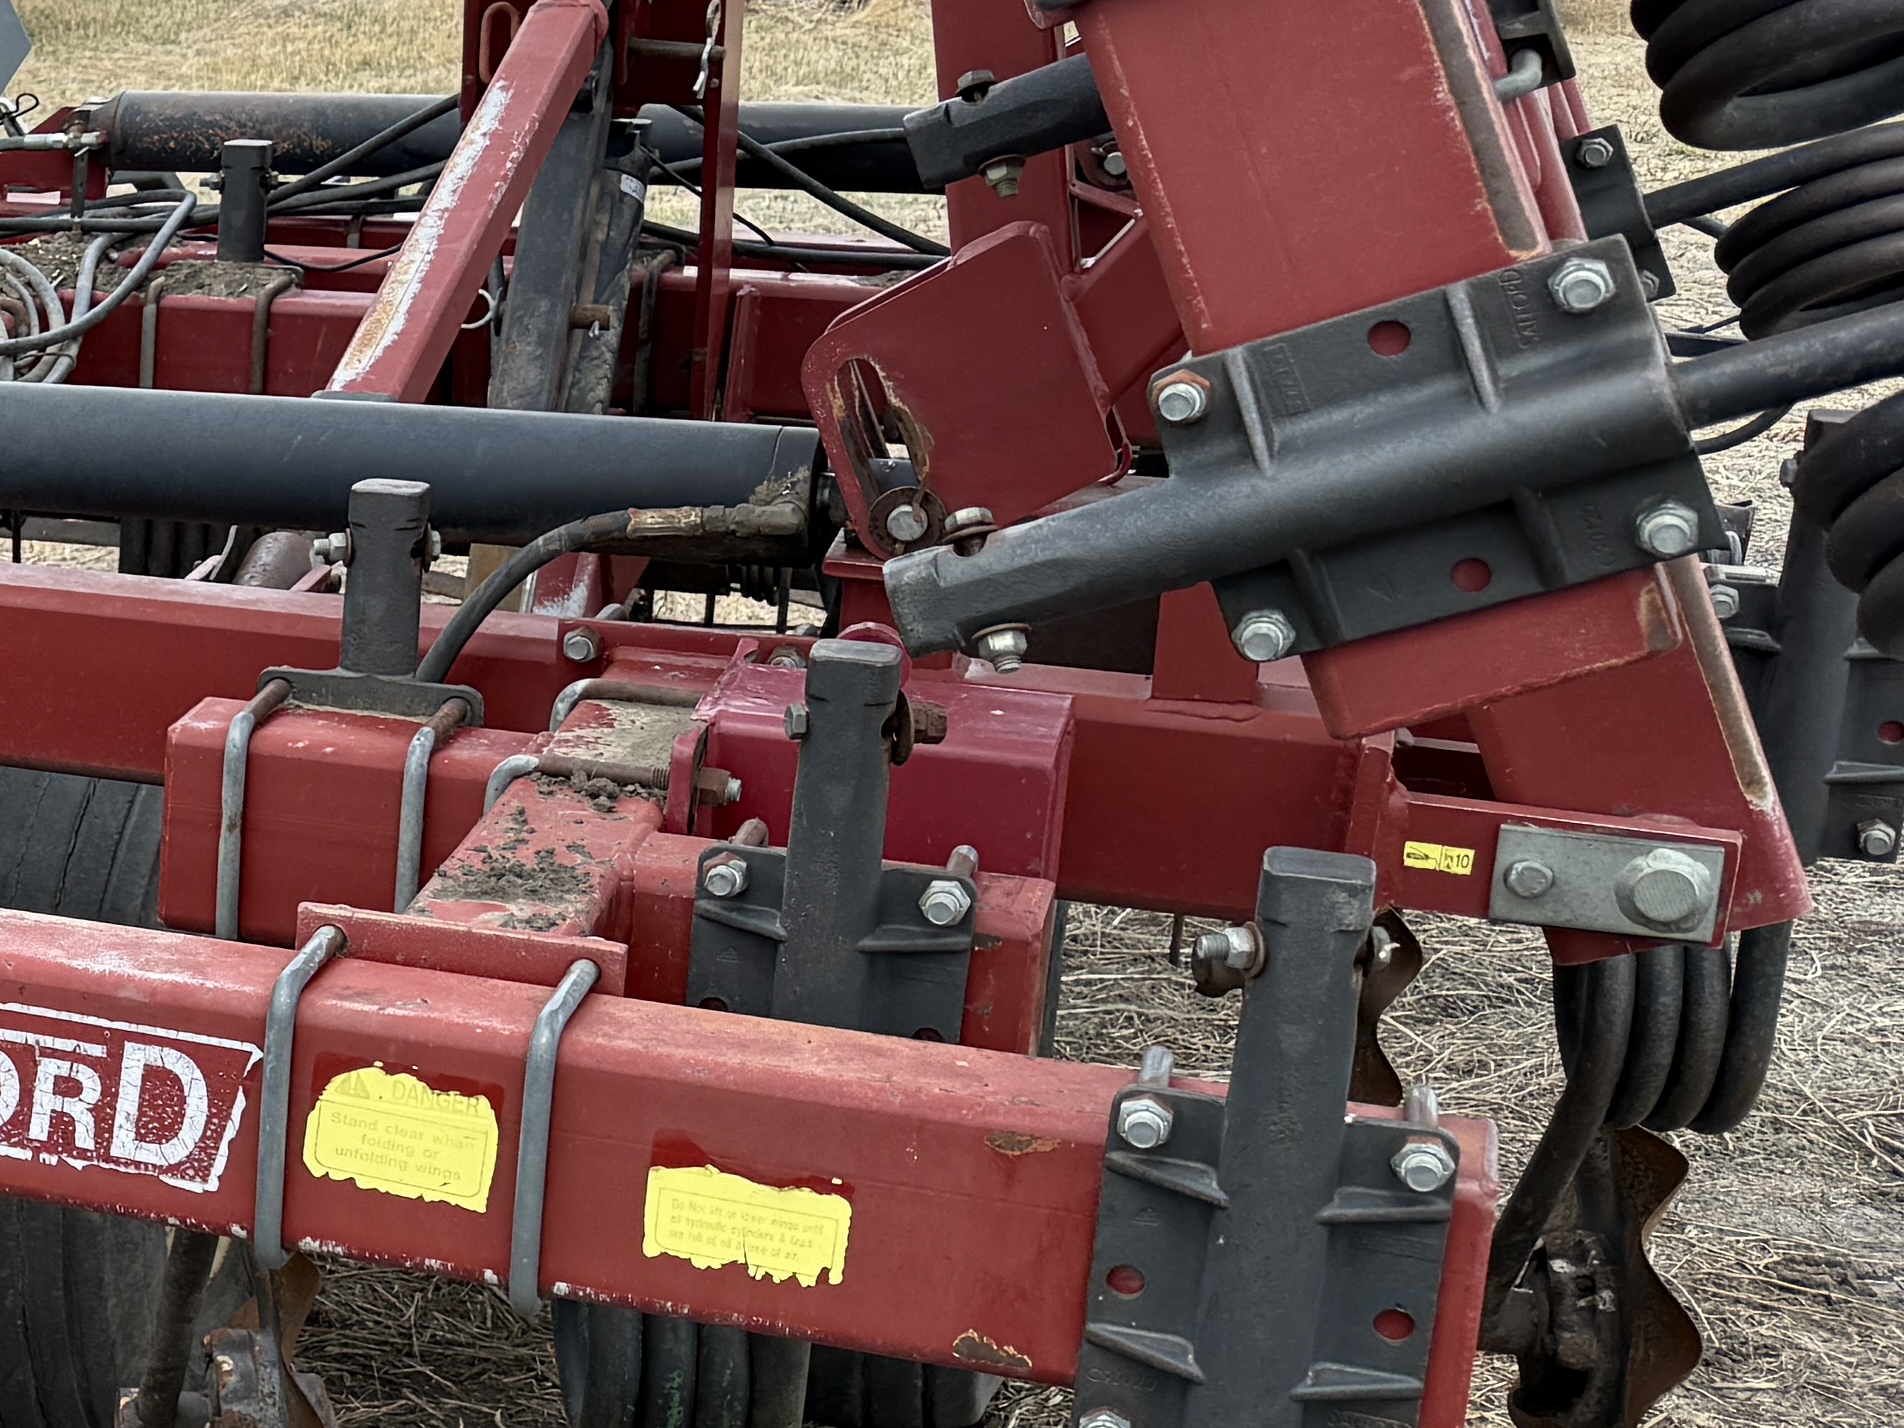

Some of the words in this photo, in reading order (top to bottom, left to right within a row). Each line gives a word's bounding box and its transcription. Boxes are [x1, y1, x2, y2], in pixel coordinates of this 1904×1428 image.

[1456, 854, 1470, 868] 10
[392, 1080, 480, 1117] DANGER
[331, 1112, 378, 1131] Stand
[385, 1125, 426, 1141] clear
[432, 1134, 475, 1151] when
[361, 1134, 415, 1158] folding
[423, 1149, 440, 1159] or
[335, 1147, 408, 1172] unfolding
[415, 1162, 461, 1181] wings
